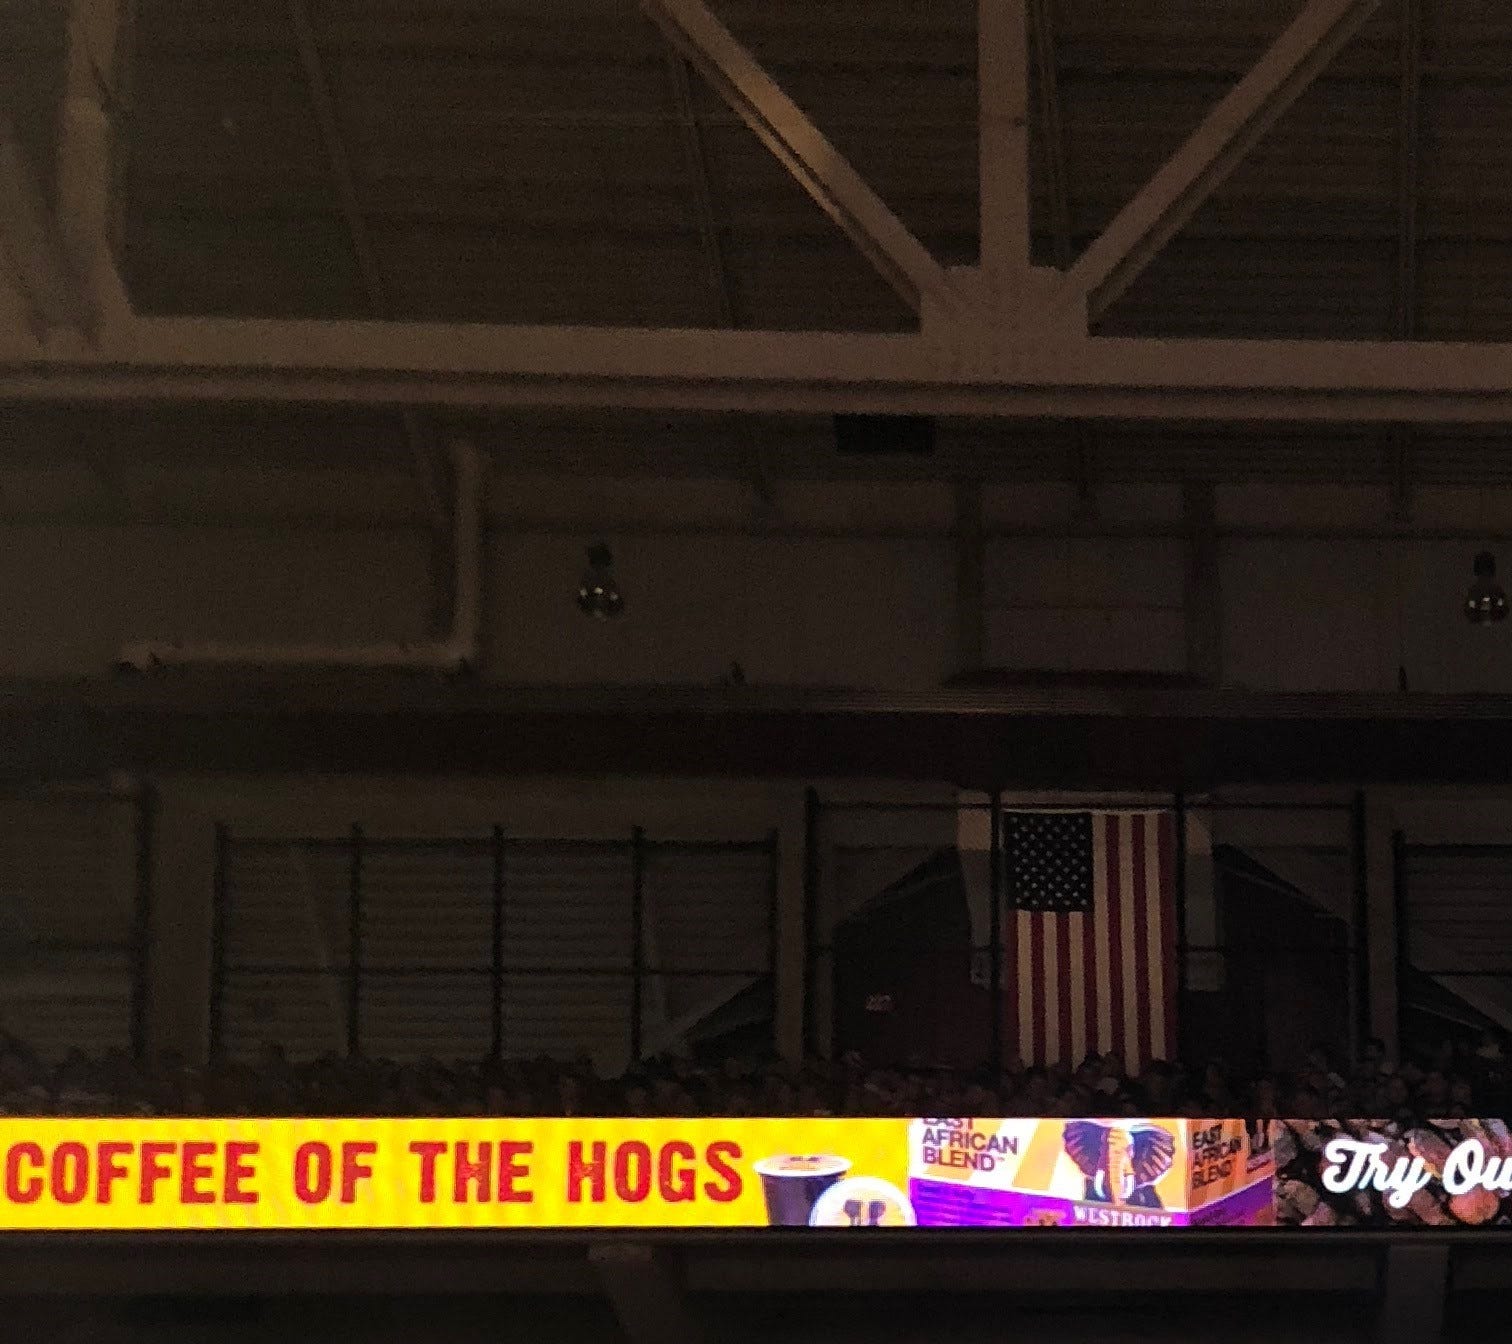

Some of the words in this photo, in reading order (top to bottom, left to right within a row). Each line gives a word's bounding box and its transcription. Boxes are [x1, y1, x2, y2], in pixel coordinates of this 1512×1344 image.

[921, 1127, 1019, 1155] AFRICAN
[922, 1145, 996, 1173] BLEND
[4, 1140, 260, 1205] COFFEE
[293, 1140, 379, 1203] OF
[409, 1140, 535, 1203] THE
[567, 1140, 744, 1203] HOGS
[1321, 1138, 1434, 1209] Try
